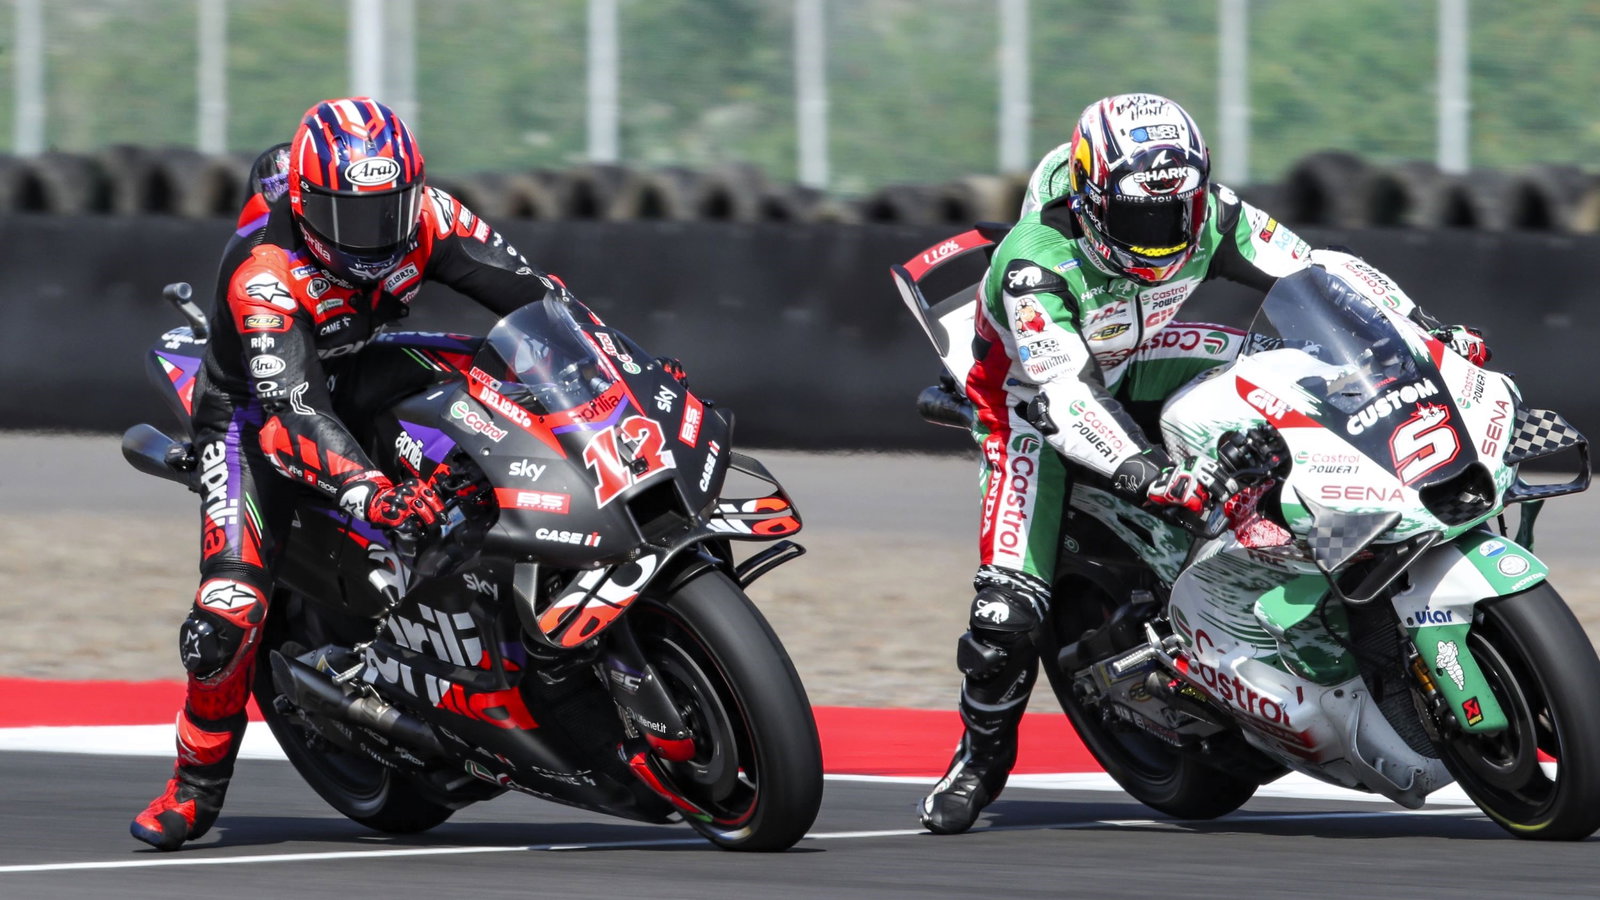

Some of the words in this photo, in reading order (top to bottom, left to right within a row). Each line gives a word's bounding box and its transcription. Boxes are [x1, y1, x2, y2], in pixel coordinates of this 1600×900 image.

[352, 161, 393, 179] Arai
[1133, 167, 1187, 183] SHARK
[1116, 194, 1144, 203] GIVES
[1151, 195, 1172, 203] YOU
[923, 240, 959, 264] 110%
[1152, 284, 1188, 301] Castrol
[321, 320, 341, 336] CAME
[252, 359, 280, 372] Arai
[471, 367, 493, 386] MVK
[1461, 367, 1477, 398] Castrol
[654, 385, 678, 413] sky
[1247, 388, 1292, 420] GIVI
[1347, 378, 1439, 436] CUSTOM
[681, 406, 698, 442] BS
[1083, 411, 1127, 453] Castrol
[1482, 400, 1510, 457] SENA
[1072, 421, 1120, 463] POWER1
[1389, 402, 1461, 486] 5
[508, 459, 546, 481] sky
[583, 415, 677, 509] 12
[700, 448, 716, 492] CASE
[1311, 452, 1360, 464] Castrol
[318, 480, 338, 494] racer
[517, 492, 565, 507] BS
[982, 440, 1002, 537] HONDA
[1321, 485, 1405, 502] SENA
[201, 441, 239, 560] aprilia
[999, 456, 1034, 558] Castrol
[536, 528, 583, 545] CASE
[463, 573, 498, 601] sky
[1415, 606, 1452, 624] viar
